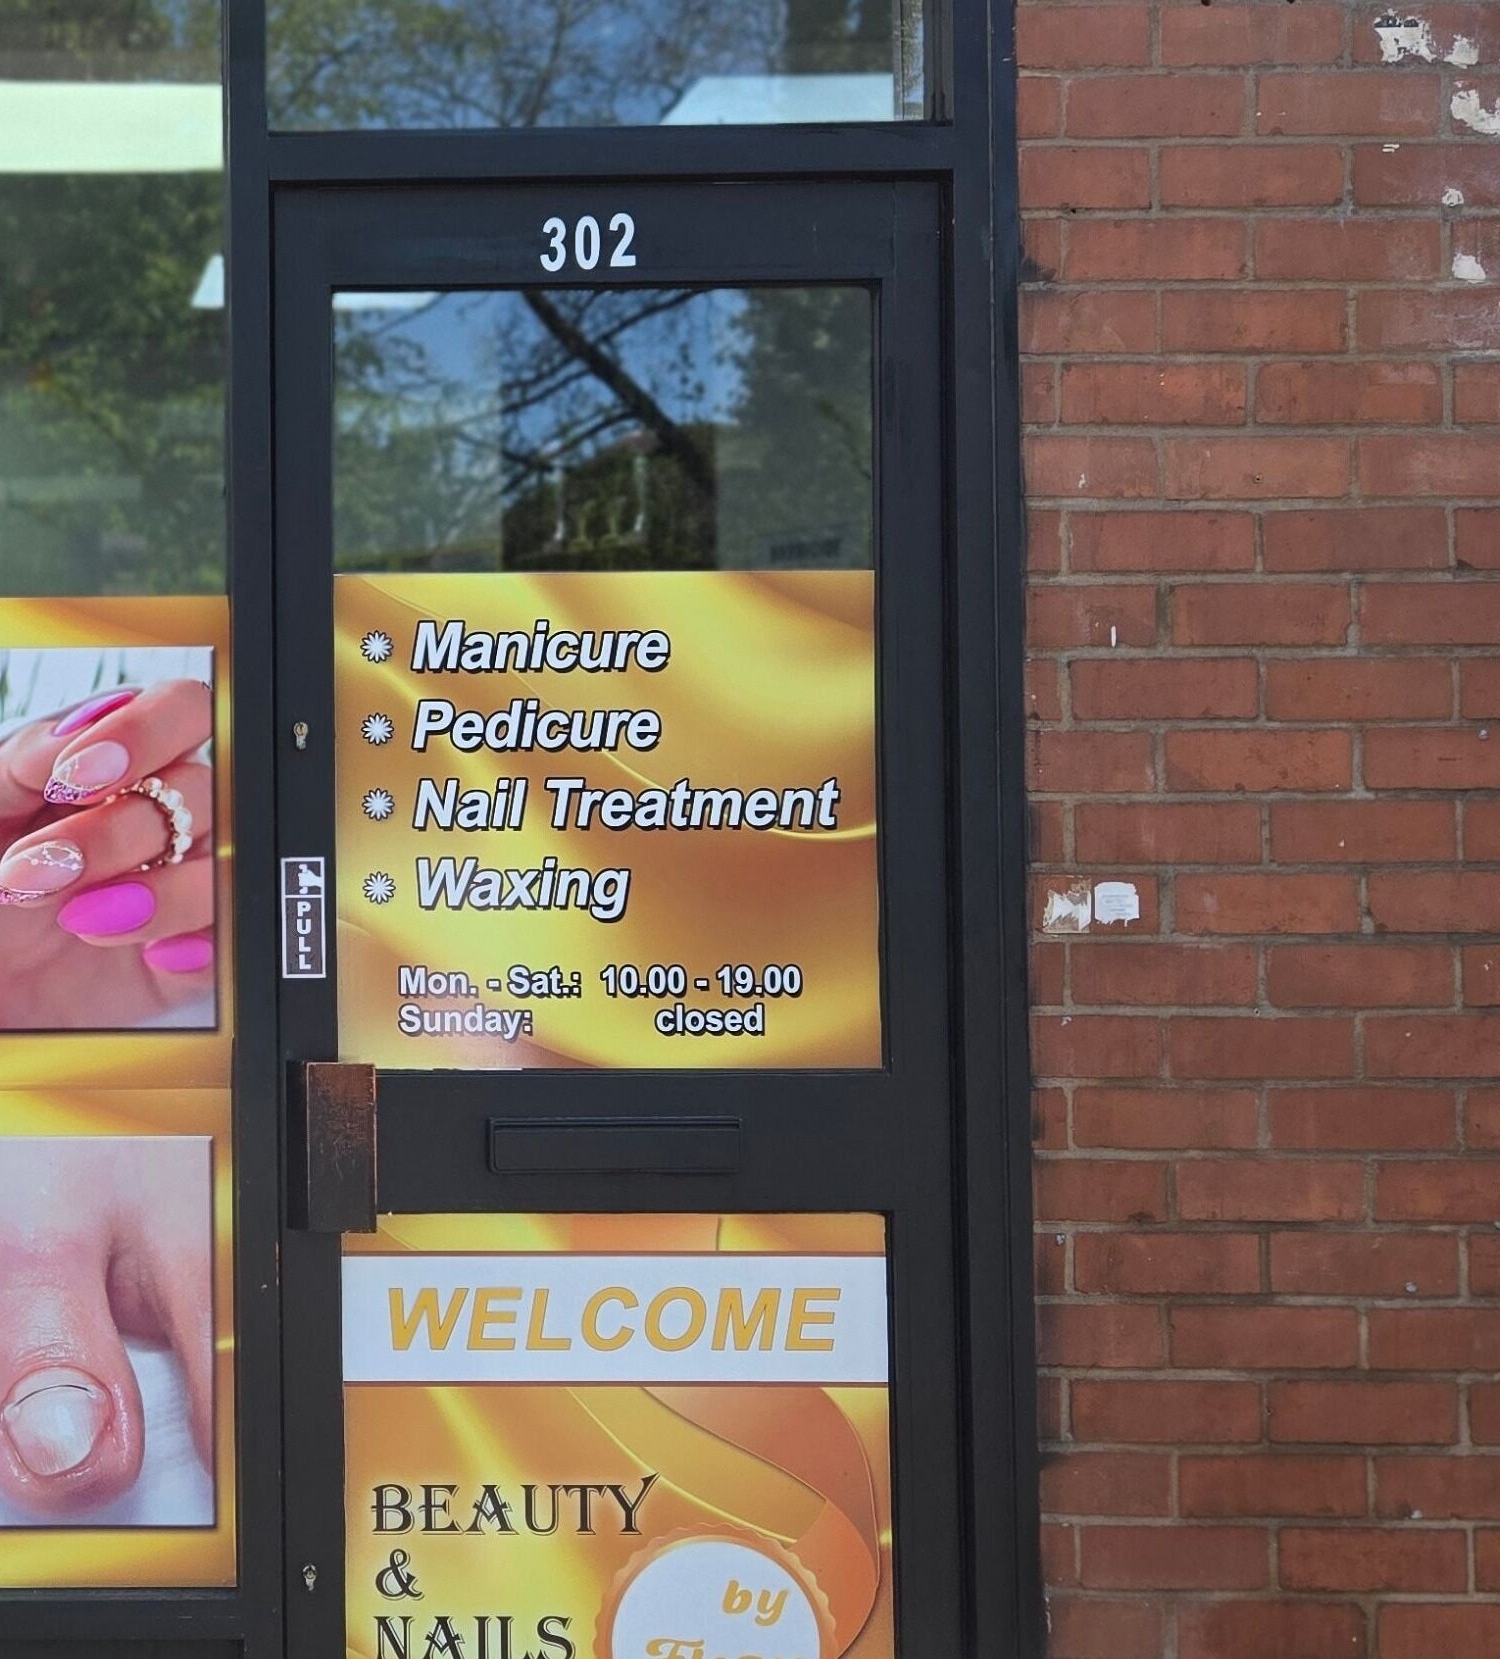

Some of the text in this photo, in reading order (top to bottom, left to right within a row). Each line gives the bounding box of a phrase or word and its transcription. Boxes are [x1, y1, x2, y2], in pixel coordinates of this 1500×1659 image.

[540, 212, 637, 272] 302
[411, 621, 671, 673] Manicure
[411, 700, 662, 753] Pedicure
[413, 778, 839, 831] Nail Treatment
[416, 858, 631, 921] Waxing
[296, 901, 312, 970] PULL
[399, 966, 478, 998] Mon.
[507, 966, 581, 998] Sat.:
[599, 966, 685, 997] 10.00
[715, 966, 803, 997] 19.00
[399, 1004, 765, 1040] Sunday: closed
[387, 1286, 842, 1352] WELCOME
[371, 1472, 660, 1536] BEAUTY
[375, 1547, 425, 1601] &
[722, 1579, 790, 1627] by
[372, 1615, 577, 1659] NAILS
